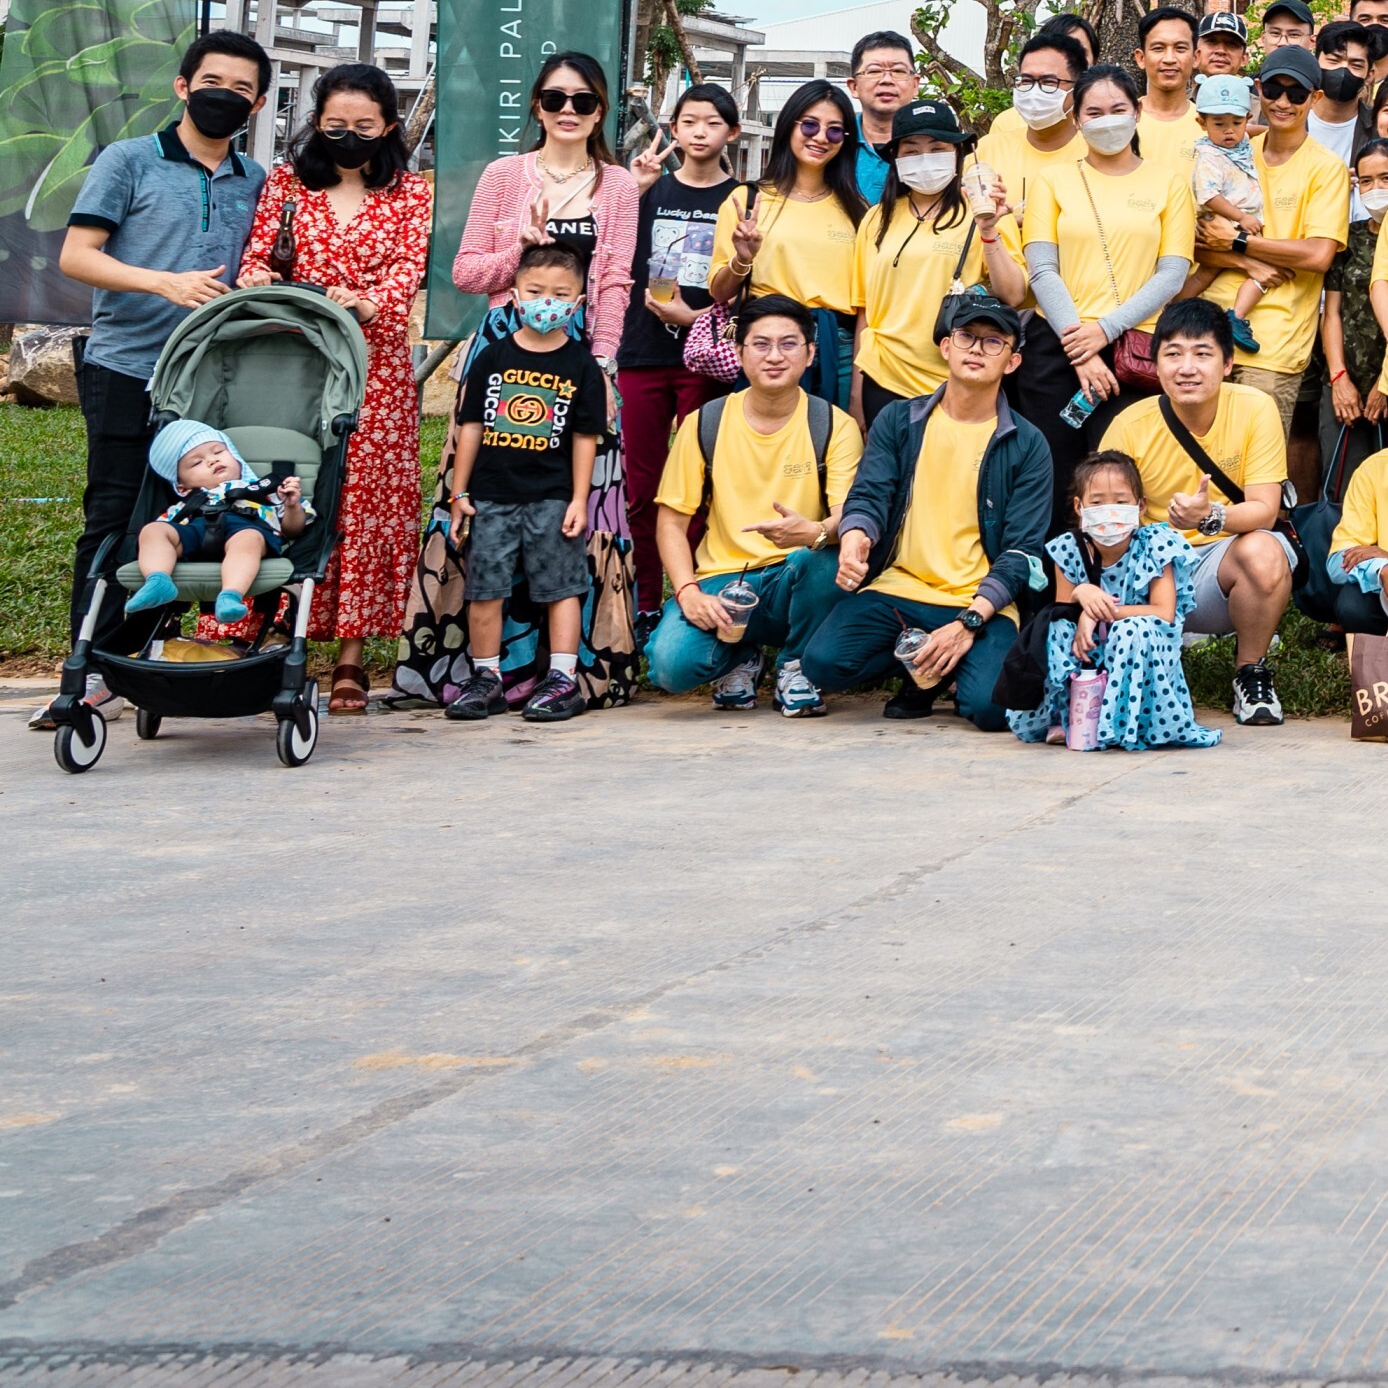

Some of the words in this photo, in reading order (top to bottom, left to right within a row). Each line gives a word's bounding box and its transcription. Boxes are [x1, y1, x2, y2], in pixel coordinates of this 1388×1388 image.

[499, 78, 521, 156] KIRI
[656, 206, 691, 219] Lucky
[503, 368, 560, 390] GUCCI
[484, 373, 503, 427] GUCCI
[549, 397, 571, 448] GUCCI
[491, 431, 548, 451] GUCCI
